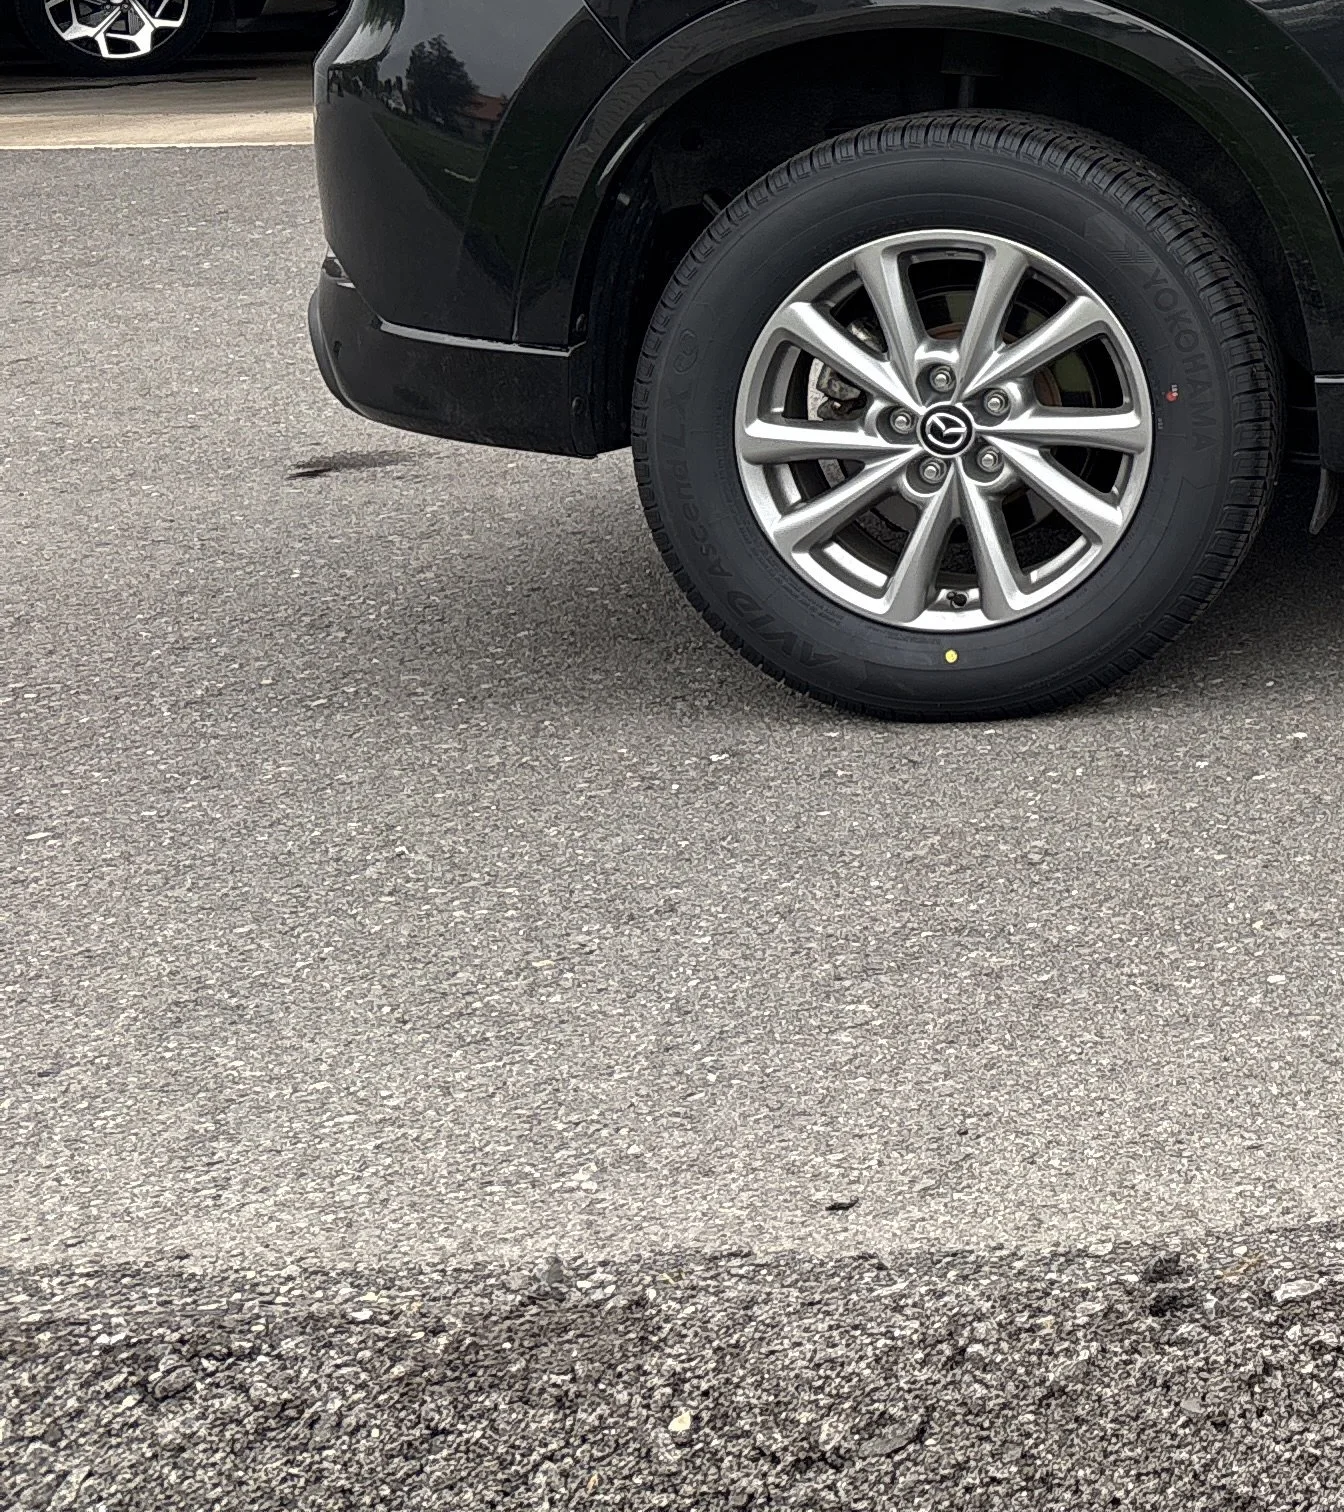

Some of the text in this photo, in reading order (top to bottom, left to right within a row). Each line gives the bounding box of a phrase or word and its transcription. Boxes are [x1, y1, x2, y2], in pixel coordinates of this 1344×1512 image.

[1141, 266, 1221, 452] YOKOHAMA
[668, 458, 734, 579] Ascend
[727, 588, 838, 669] AVID
